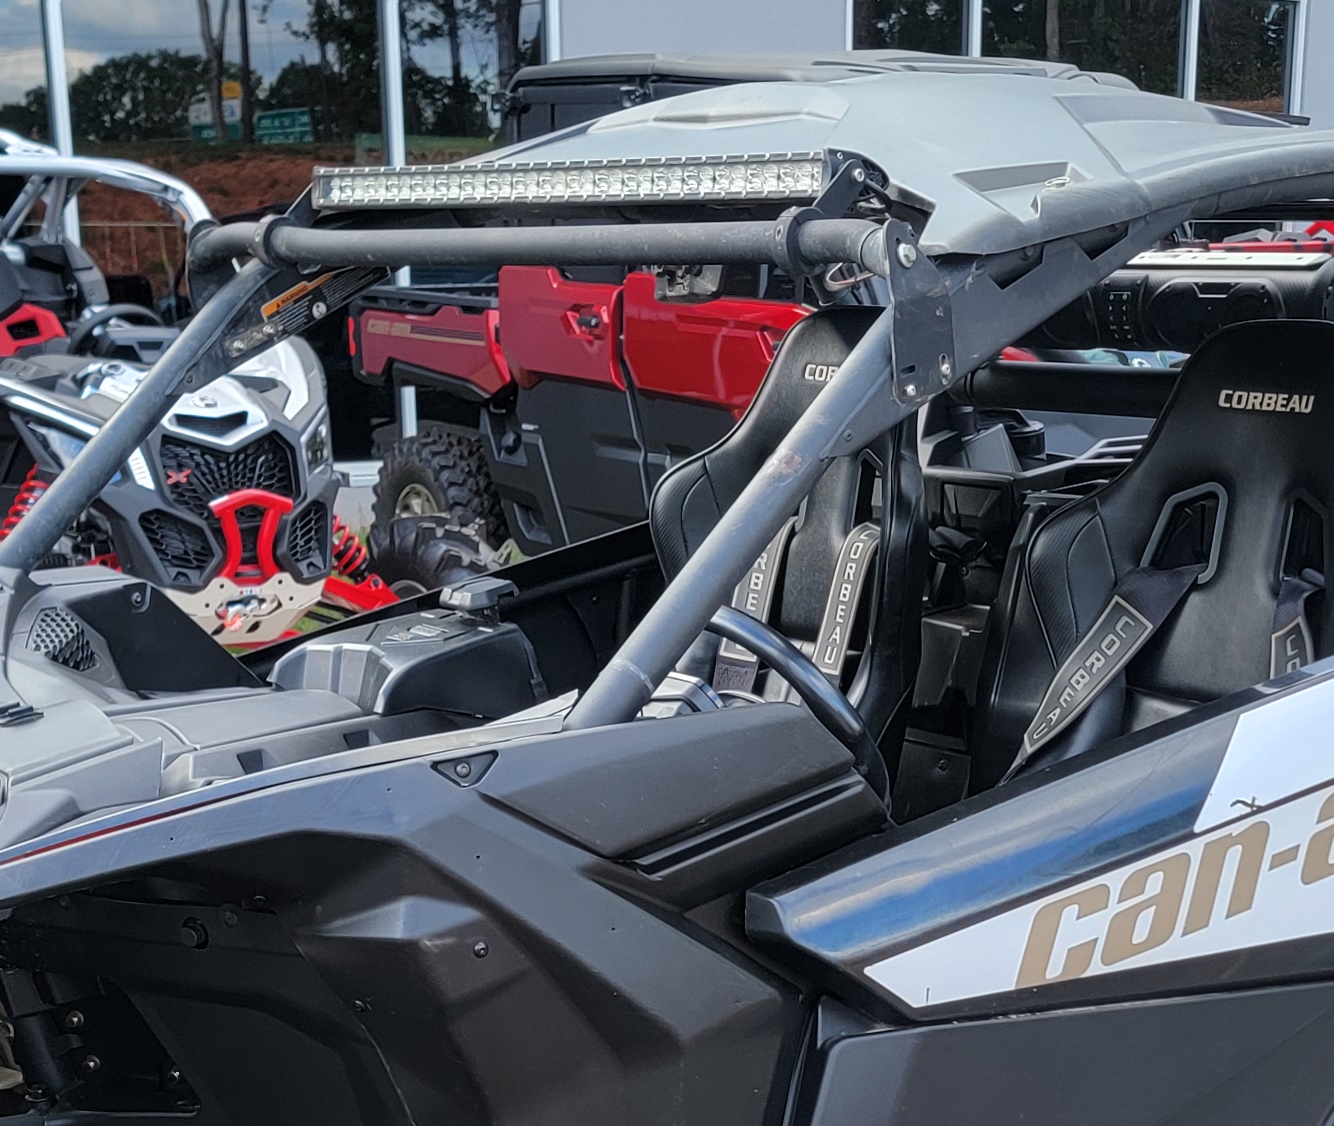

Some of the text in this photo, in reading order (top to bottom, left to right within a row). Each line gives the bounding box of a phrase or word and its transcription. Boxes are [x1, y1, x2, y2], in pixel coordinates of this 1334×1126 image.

[1218, 389, 1315, 414] CORBEAU
[823, 530, 880, 665] CORBEAU
[1033, 615, 1135, 740] CORBEAU
